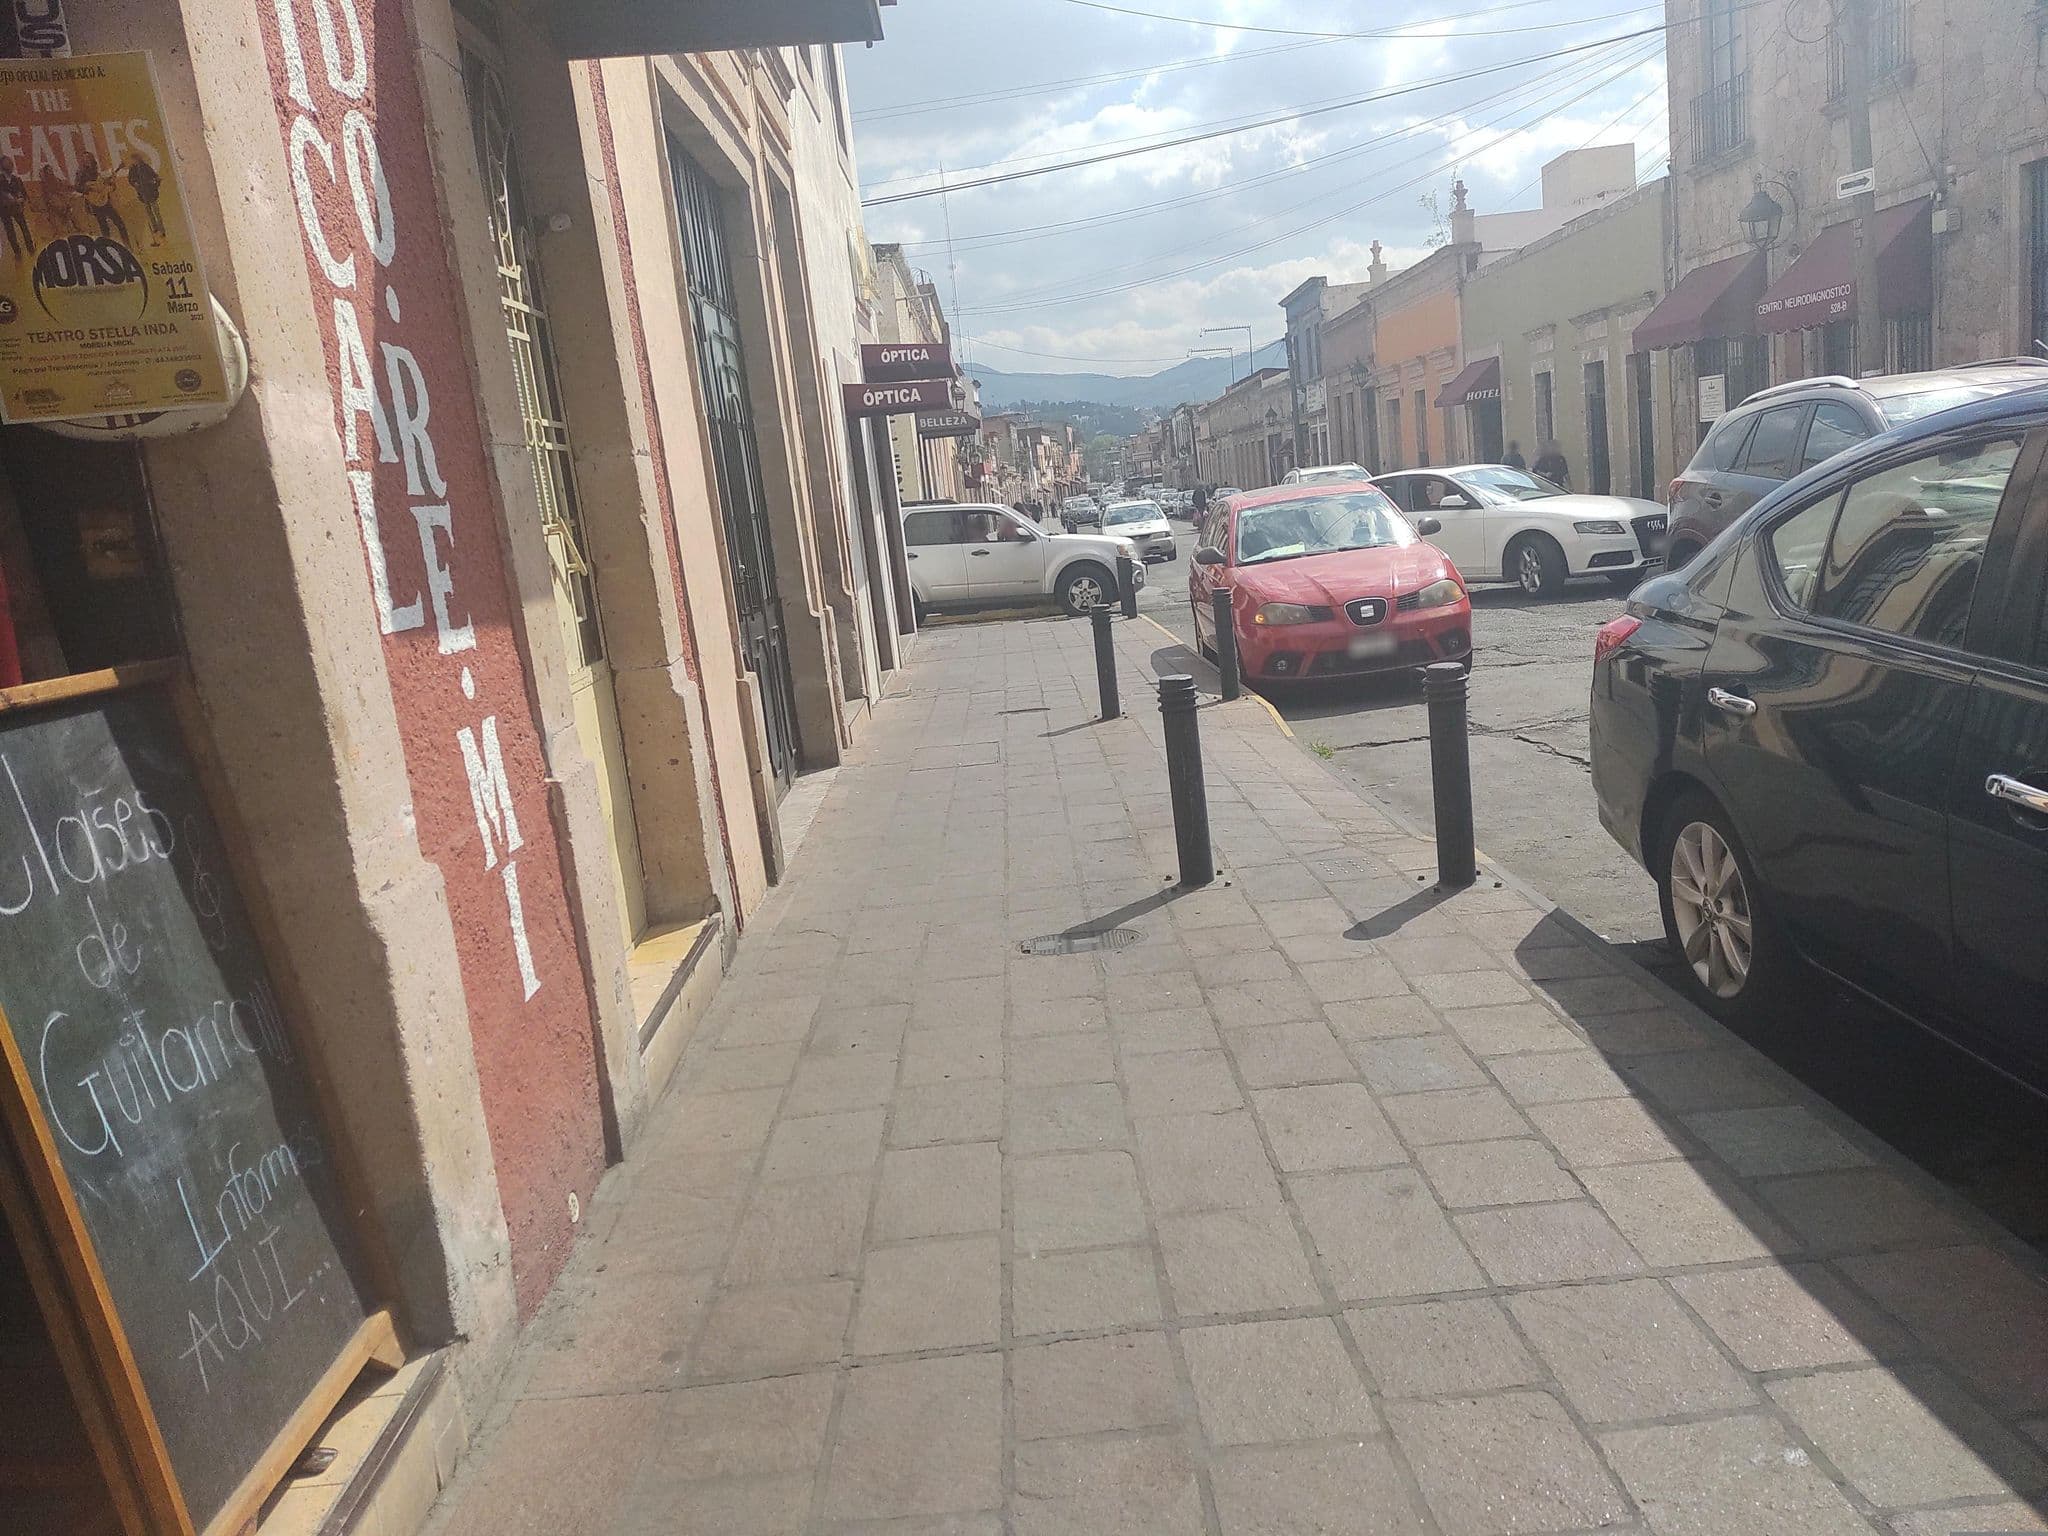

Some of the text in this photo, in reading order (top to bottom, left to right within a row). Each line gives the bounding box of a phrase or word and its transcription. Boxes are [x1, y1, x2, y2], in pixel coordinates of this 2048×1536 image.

[26, 89, 72, 112] THE
[33, 235, 145, 288] MORSA
[165, 276, 193, 299] 11
[167, 301, 199, 314] Marzo
[1758, 283, 1851, 315] CENTRO NEURODIAGNOSTICO
[27, 322, 178, 344] TEATRO STELLA INDA
[881, 348, 930, 363] ÓPTICA
[863, 388, 922, 406] ÓPTICA
[1466, 388, 1500, 401] HOTEL
[919, 414, 968, 428] BELLEZA
[76, 895, 141, 987] de
